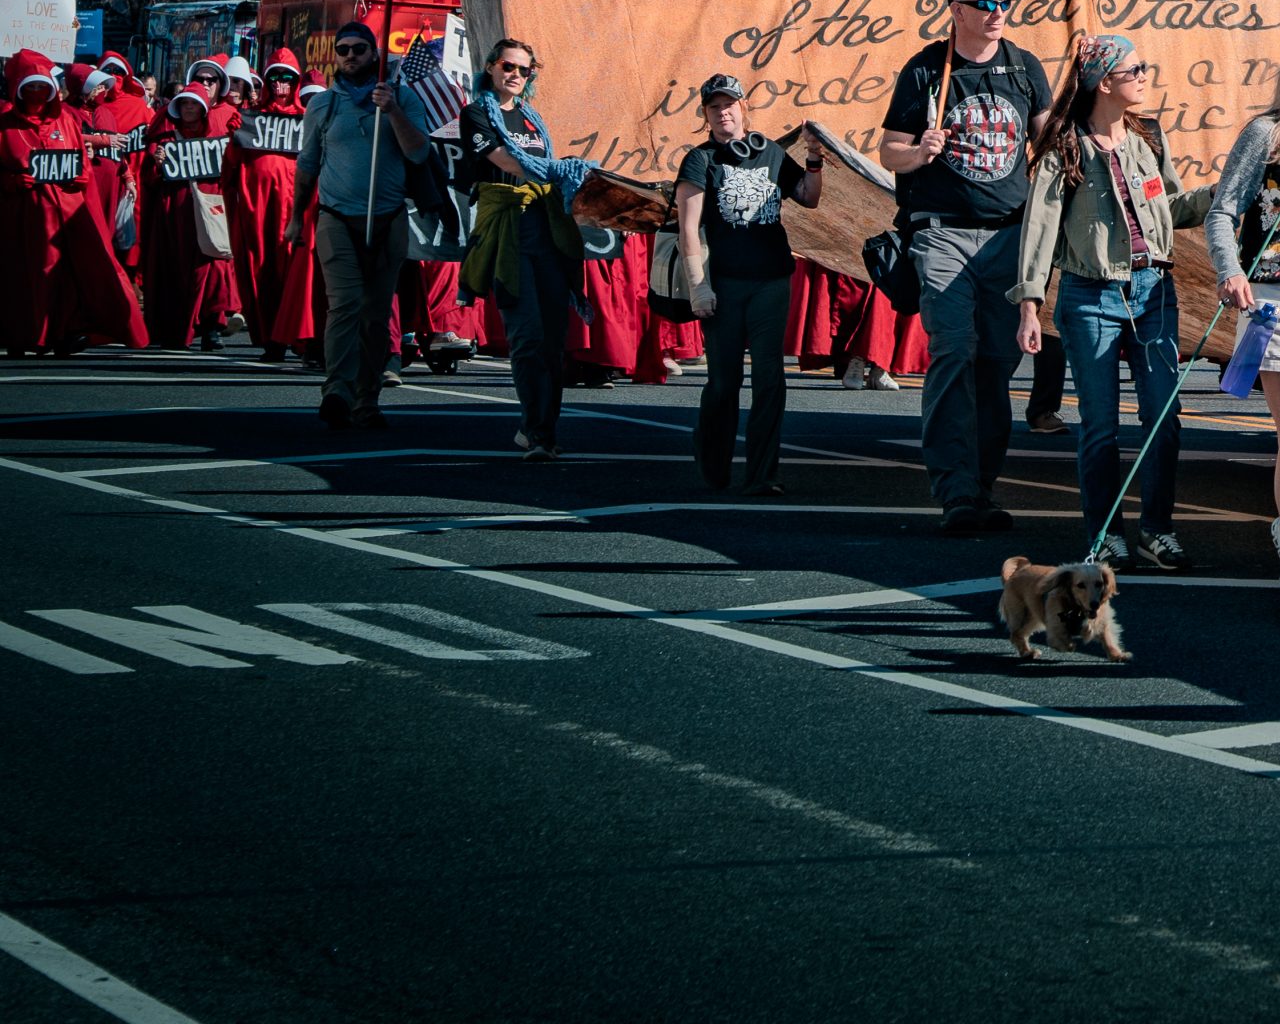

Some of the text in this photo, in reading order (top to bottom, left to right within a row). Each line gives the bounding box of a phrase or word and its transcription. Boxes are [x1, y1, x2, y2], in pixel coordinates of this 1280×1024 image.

[26, 0, 59, 18] LOVE
[30, 21, 46, 31] THE
[50, 22, 70, 33] ONLY
[3, 34, 70, 55] ANSWER
[306, 35, 337, 63] CAPIT
[1187, 59, 1225, 88] a
[953, 107, 1013, 124] I'M ON
[252, 115, 304, 151] SHAM
[958, 132, 1008, 147] YOUR
[31, 153, 79, 181] SHAME
[962, 153, 1008, 167] LEFT
[960, 167, 982, 180] MAD
[985, 162, 1012, 180] ABOUT
